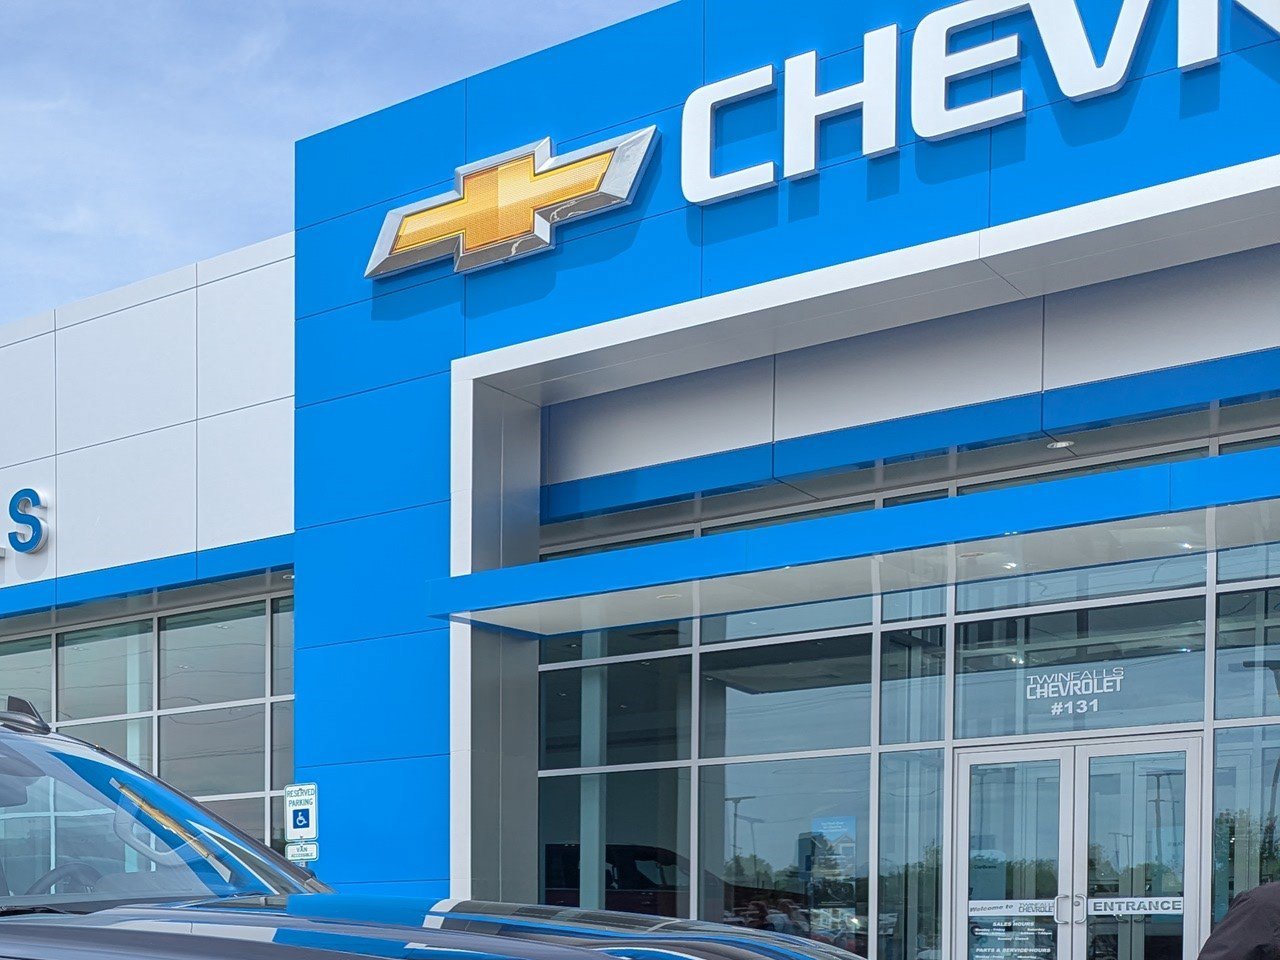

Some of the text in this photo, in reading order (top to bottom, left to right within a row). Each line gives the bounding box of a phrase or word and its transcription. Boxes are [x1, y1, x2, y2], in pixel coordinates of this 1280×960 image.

[1026, 667, 1124, 685] TWINFALLS
[1026, 677, 1124, 700] CHEVROLET
[1051, 699, 1099, 716] #131
[286, 788, 315, 798] RESERVED
[288, 798, 313, 808] PARKING
[970, 903, 1004, 912] Welcome
[1093, 900, 1182, 912] ENTRANCE
